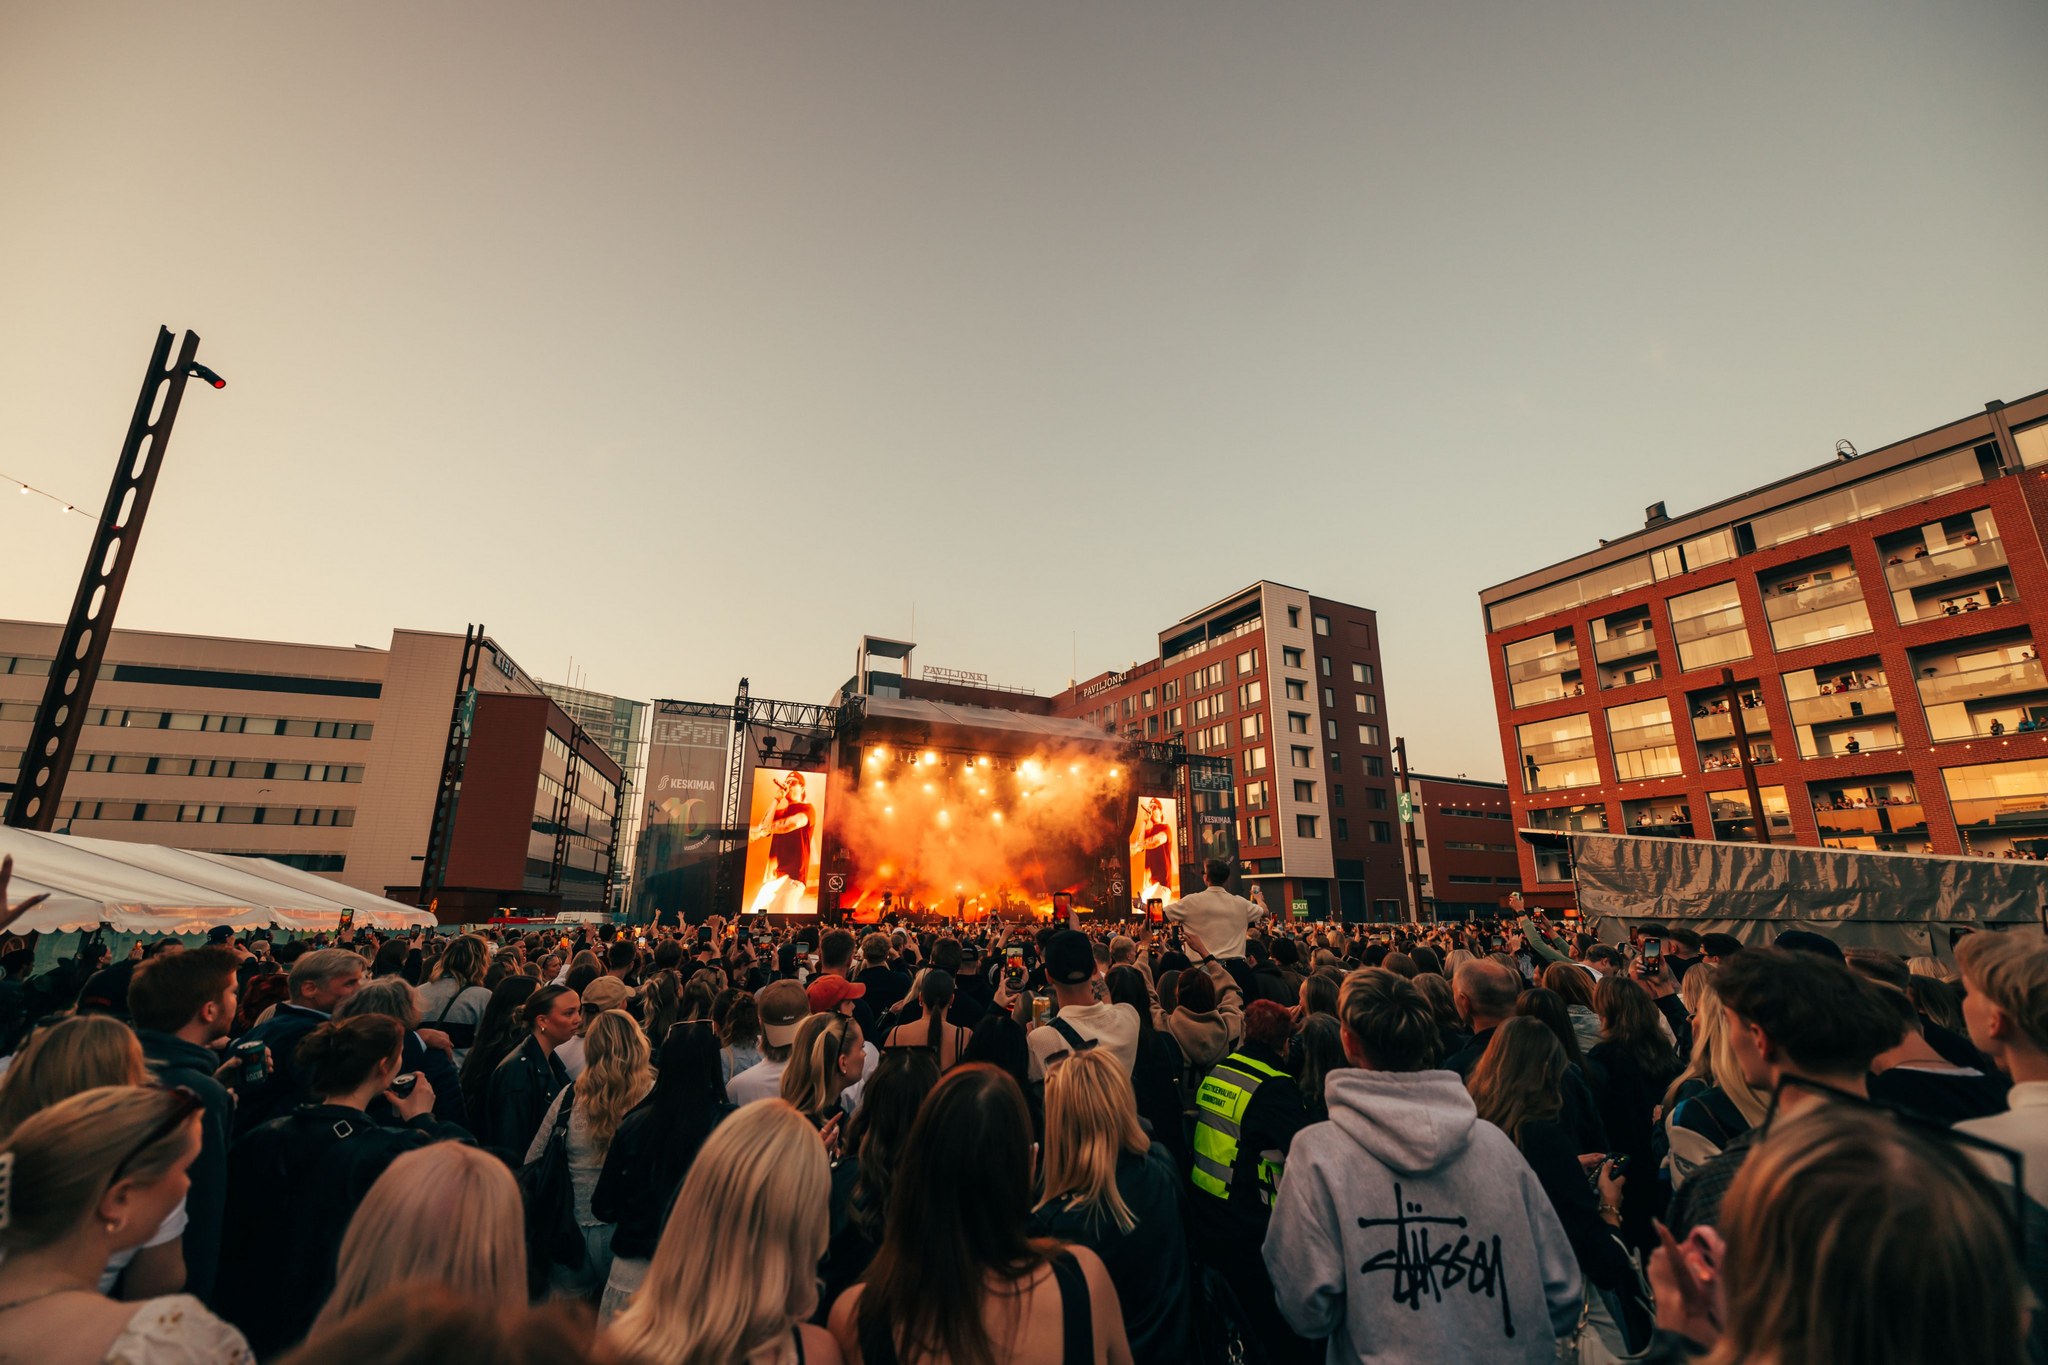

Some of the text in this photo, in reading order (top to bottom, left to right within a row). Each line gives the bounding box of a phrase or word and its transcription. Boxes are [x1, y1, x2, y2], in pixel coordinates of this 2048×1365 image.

[923, 665, 988, 681] PAVILJONKI
[1083, 671, 1127, 697] PAVILJONKI
[670, 778, 716, 791] KESKIMAA
[1204, 815, 1232, 825] KESKIMAA
[1292, 902, 1307, 910] EXIT
